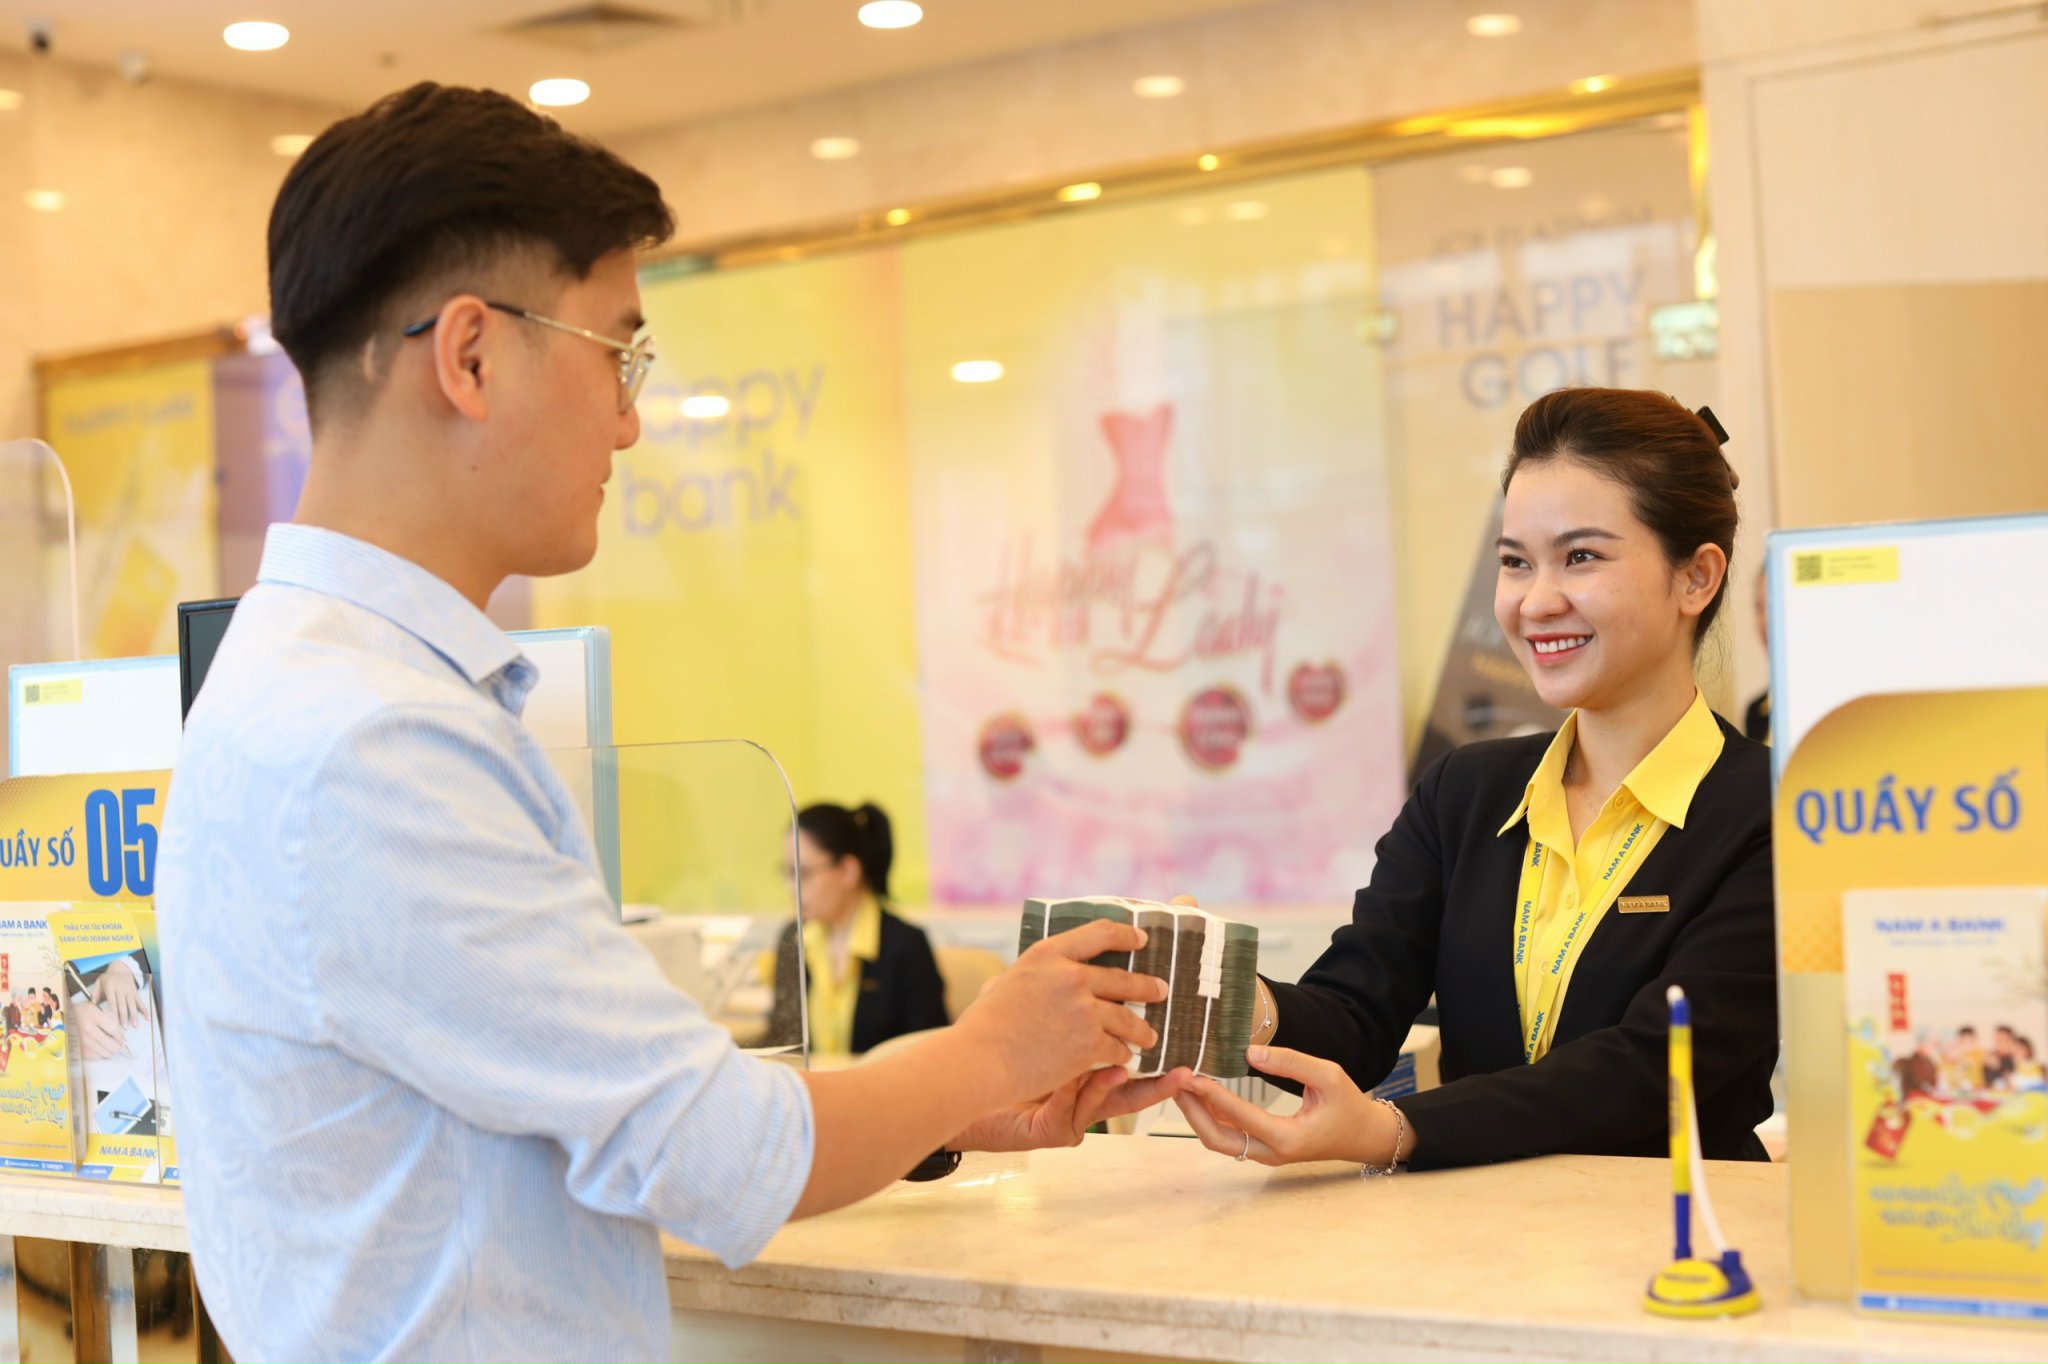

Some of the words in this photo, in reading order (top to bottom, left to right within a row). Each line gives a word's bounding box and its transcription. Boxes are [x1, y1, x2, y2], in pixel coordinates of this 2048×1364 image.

[1437, 268, 1648, 347] HAPPY
[642, 365, 825, 445] appy
[621, 448, 802, 538] bank
[1953, 765, 2021, 833] SỐ
[47, 826, 75, 867] SỐ
[85, 787, 158, 898] 05
[1603, 859, 1620, 881] NAM
[1623, 823, 1644, 850] BANK
[0, 919, 16, 930] AM
[16, 919, 23, 930] A
[23, 919, 49, 930] BANK
[1521, 900, 1532, 925] NAM
[1515, 935, 1527, 965] BANK
[1551, 949, 1566, 975] NAM
[1567, 912, 1587, 938] BANK
[1530, 1011, 1544, 1042] BANK
[99, 1145, 121, 1156] NAM
[129, 1146, 158, 1160] BANK
